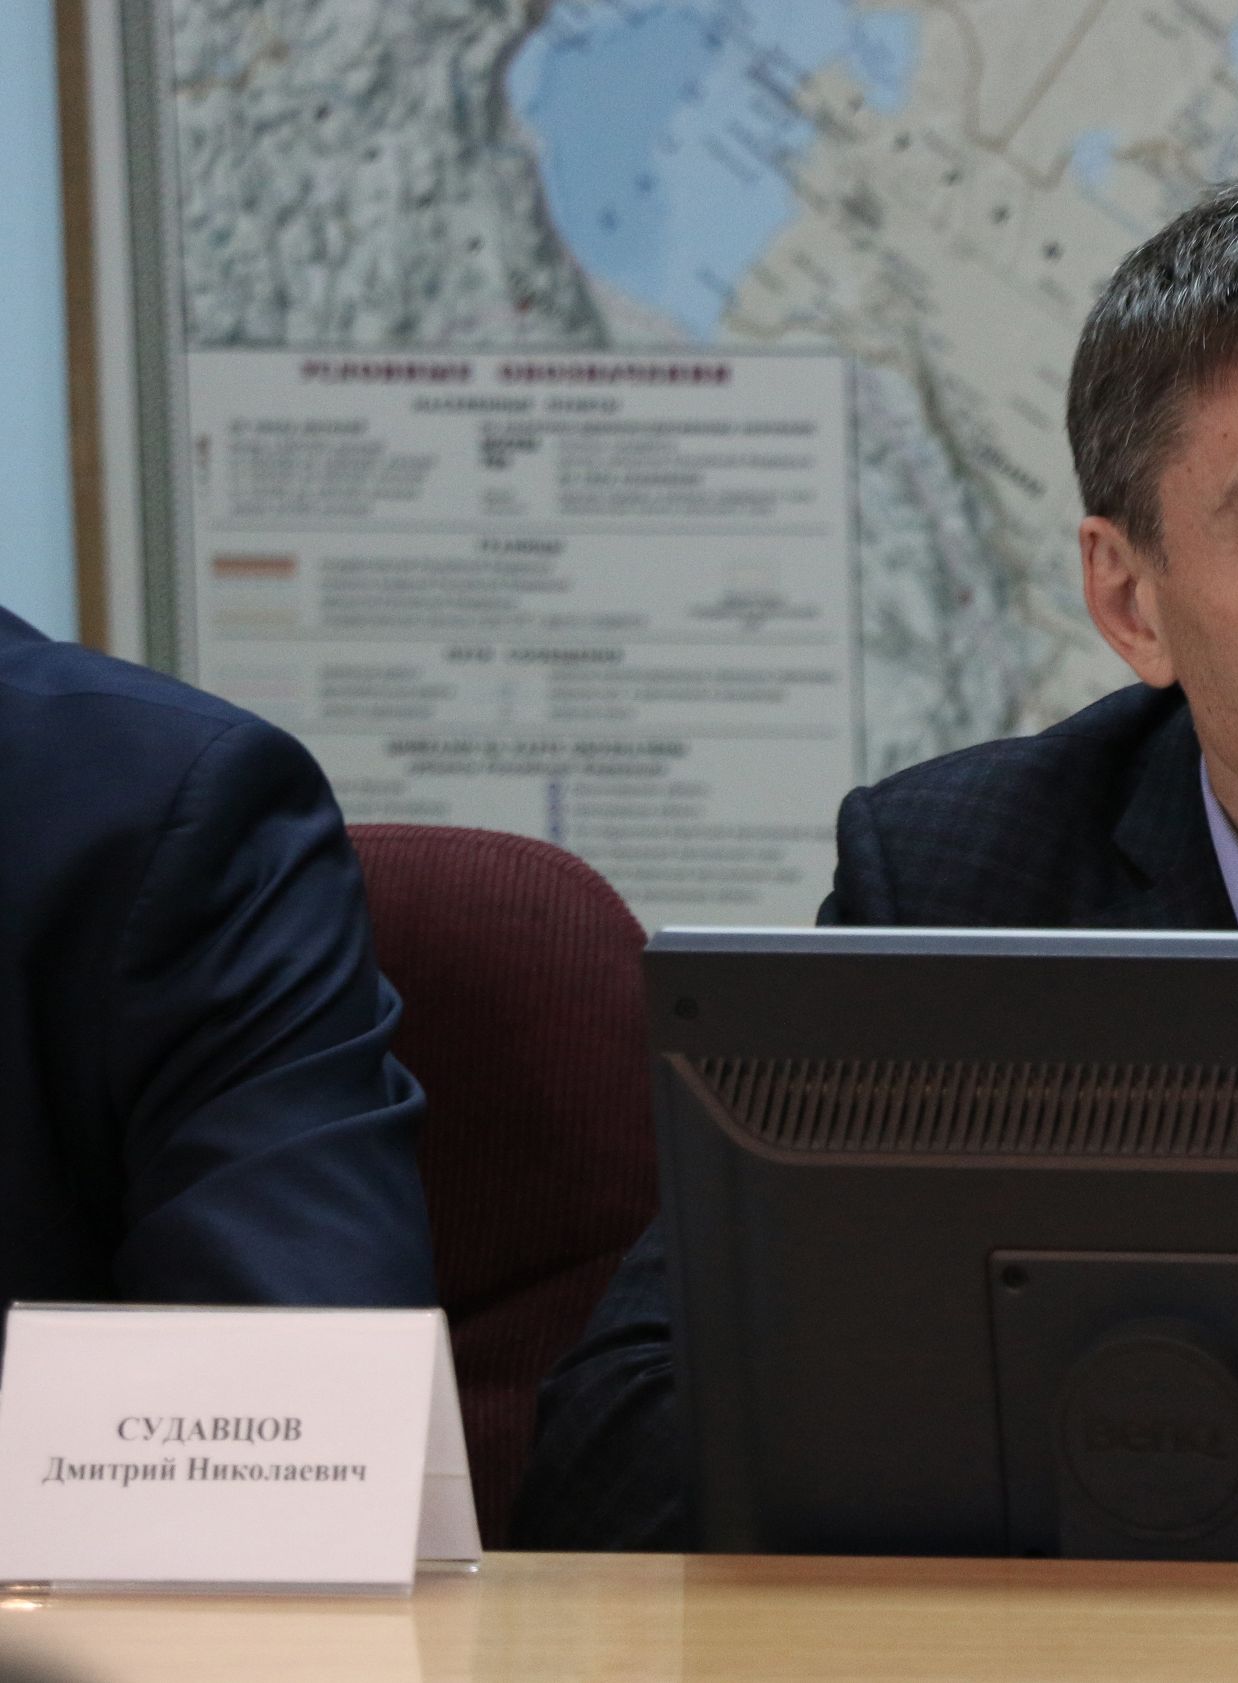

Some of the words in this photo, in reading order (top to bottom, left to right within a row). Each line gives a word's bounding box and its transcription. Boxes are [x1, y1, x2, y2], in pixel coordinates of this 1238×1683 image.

[116, 1416, 304, 1443] СУДАВЦОВ
[42, 1456, 176, 1487] Дмитрий
[187, 1457, 367, 1482] Николаевич
